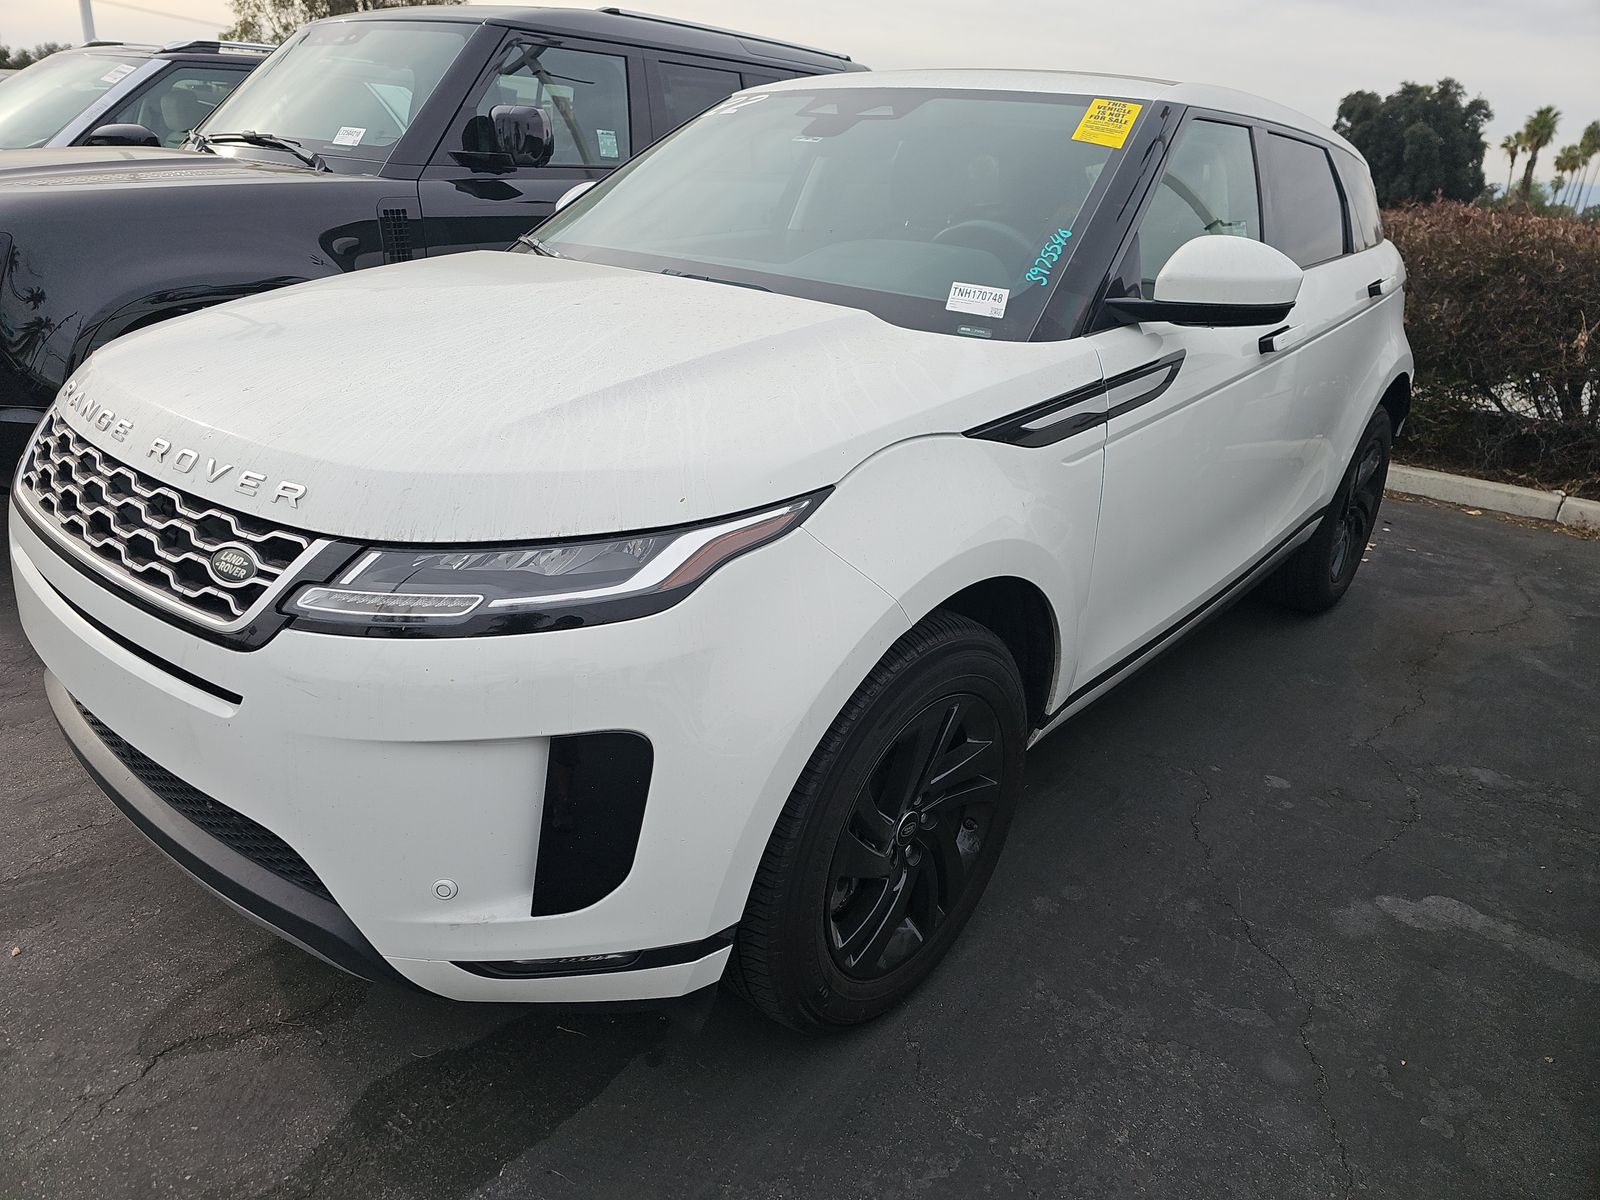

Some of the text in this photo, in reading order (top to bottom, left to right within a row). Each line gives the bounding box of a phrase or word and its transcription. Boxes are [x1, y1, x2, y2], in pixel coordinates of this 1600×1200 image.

[1097, 105, 1132, 114] VEHICLE
[1107, 117, 1129, 125] SALE
[952, 286, 1004, 304] TNH170748
[64, 380, 307, 509] RANGE ROVER
[220, 551, 245, 566] LAND
[217, 560, 247, 579] ROVER
